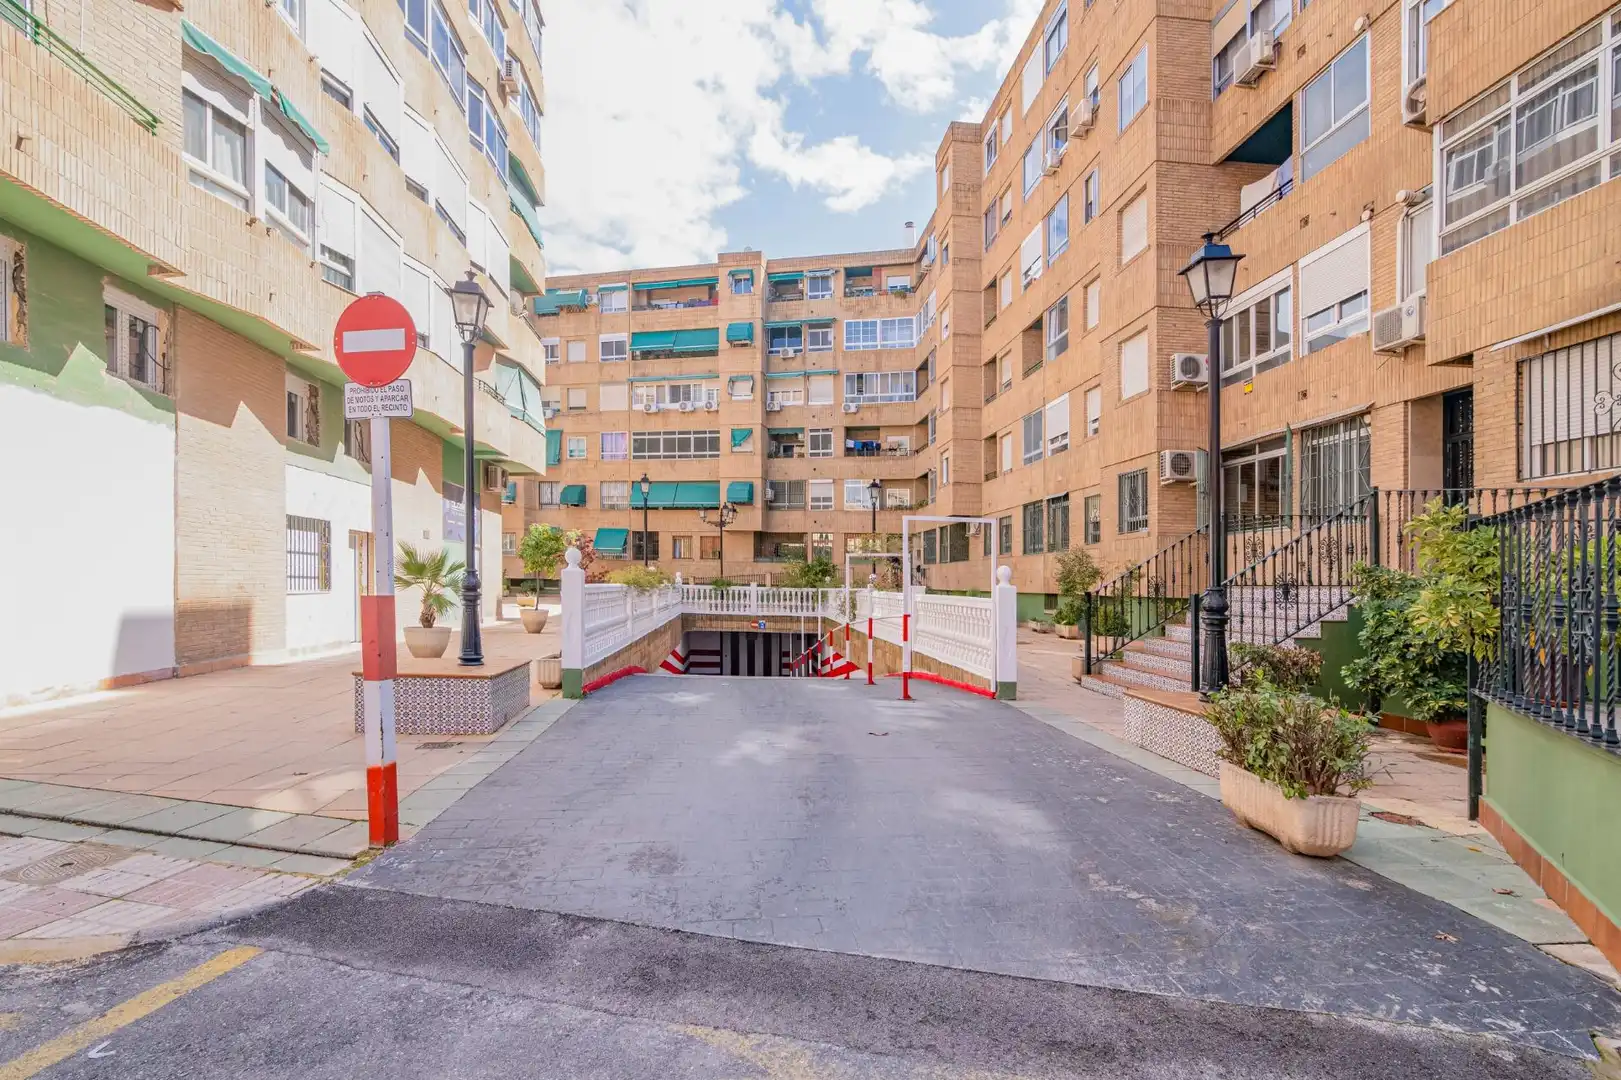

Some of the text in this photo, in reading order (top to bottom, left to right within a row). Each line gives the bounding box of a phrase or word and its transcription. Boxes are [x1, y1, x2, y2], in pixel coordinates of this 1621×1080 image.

[355, 395, 374, 403] MOTOS
[349, 405, 356, 413] EN
[373, 404, 380, 412] EL
